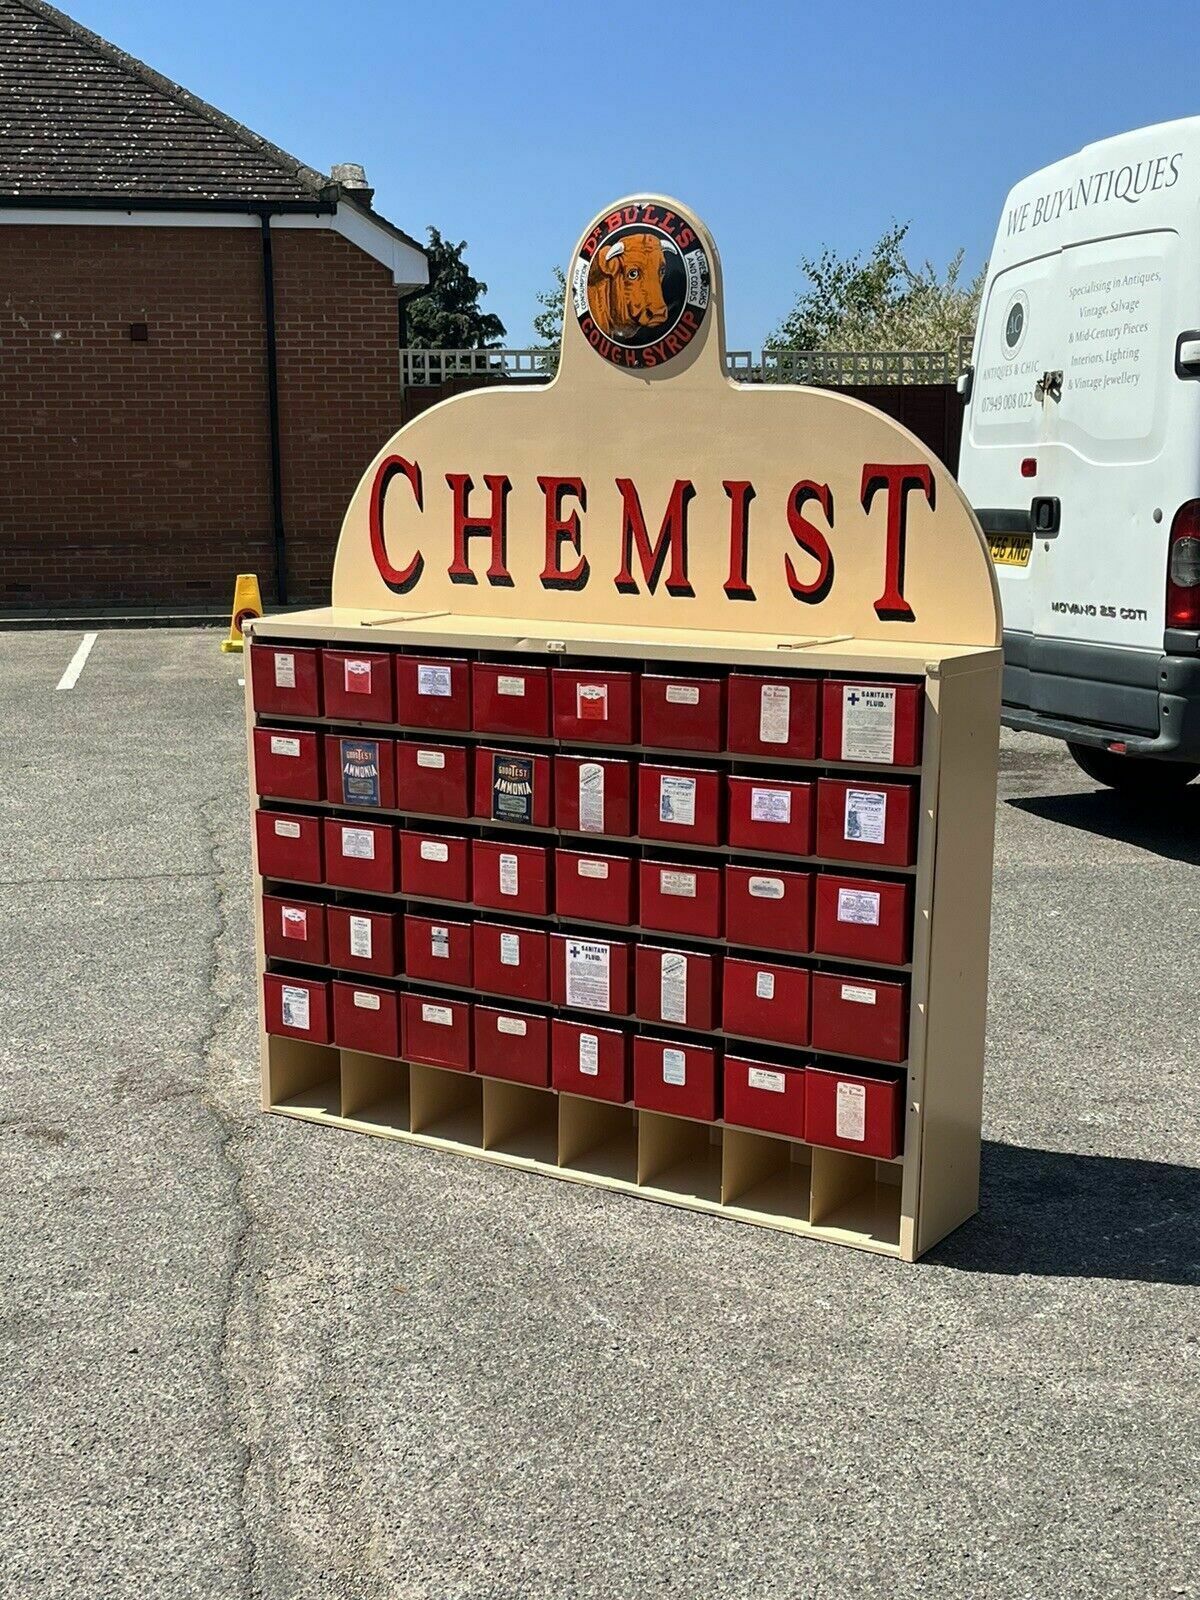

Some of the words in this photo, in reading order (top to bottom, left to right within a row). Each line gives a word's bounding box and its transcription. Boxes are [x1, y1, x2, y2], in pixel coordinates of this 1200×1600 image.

[604, 204, 697, 249] BULL'S
[1007, 203, 1031, 237] WE
[687, 257, 698, 275] AND
[1112, 278, 1121, 289] in
[1121, 272, 1162, 288] Antiques,
[1109, 298, 1140, 314] Salvage
[581, 318, 636, 366] COUGH
[642, 310, 699, 368] SYRUP
[1075, 327, 1121, 341] Mid-Century
[1122, 322, 1149, 335] Pieces
[1105, 347, 1140, 364] Lighting
[983, 364, 1013, 381] ANTIQUES
[1020, 360, 1040, 375] CHIC
[1074, 377, 1102, 391] Vintage
[1017, 391, 1033, 409] 022
[369, 454, 937, 622] CHEMIST
[1051, 602, 1097, 617] MOVANO
[861, 691, 894, 700] SANITARY
[343, 762, 378, 778] AMMONIA
[493, 778, 532, 796] AMMONIA
